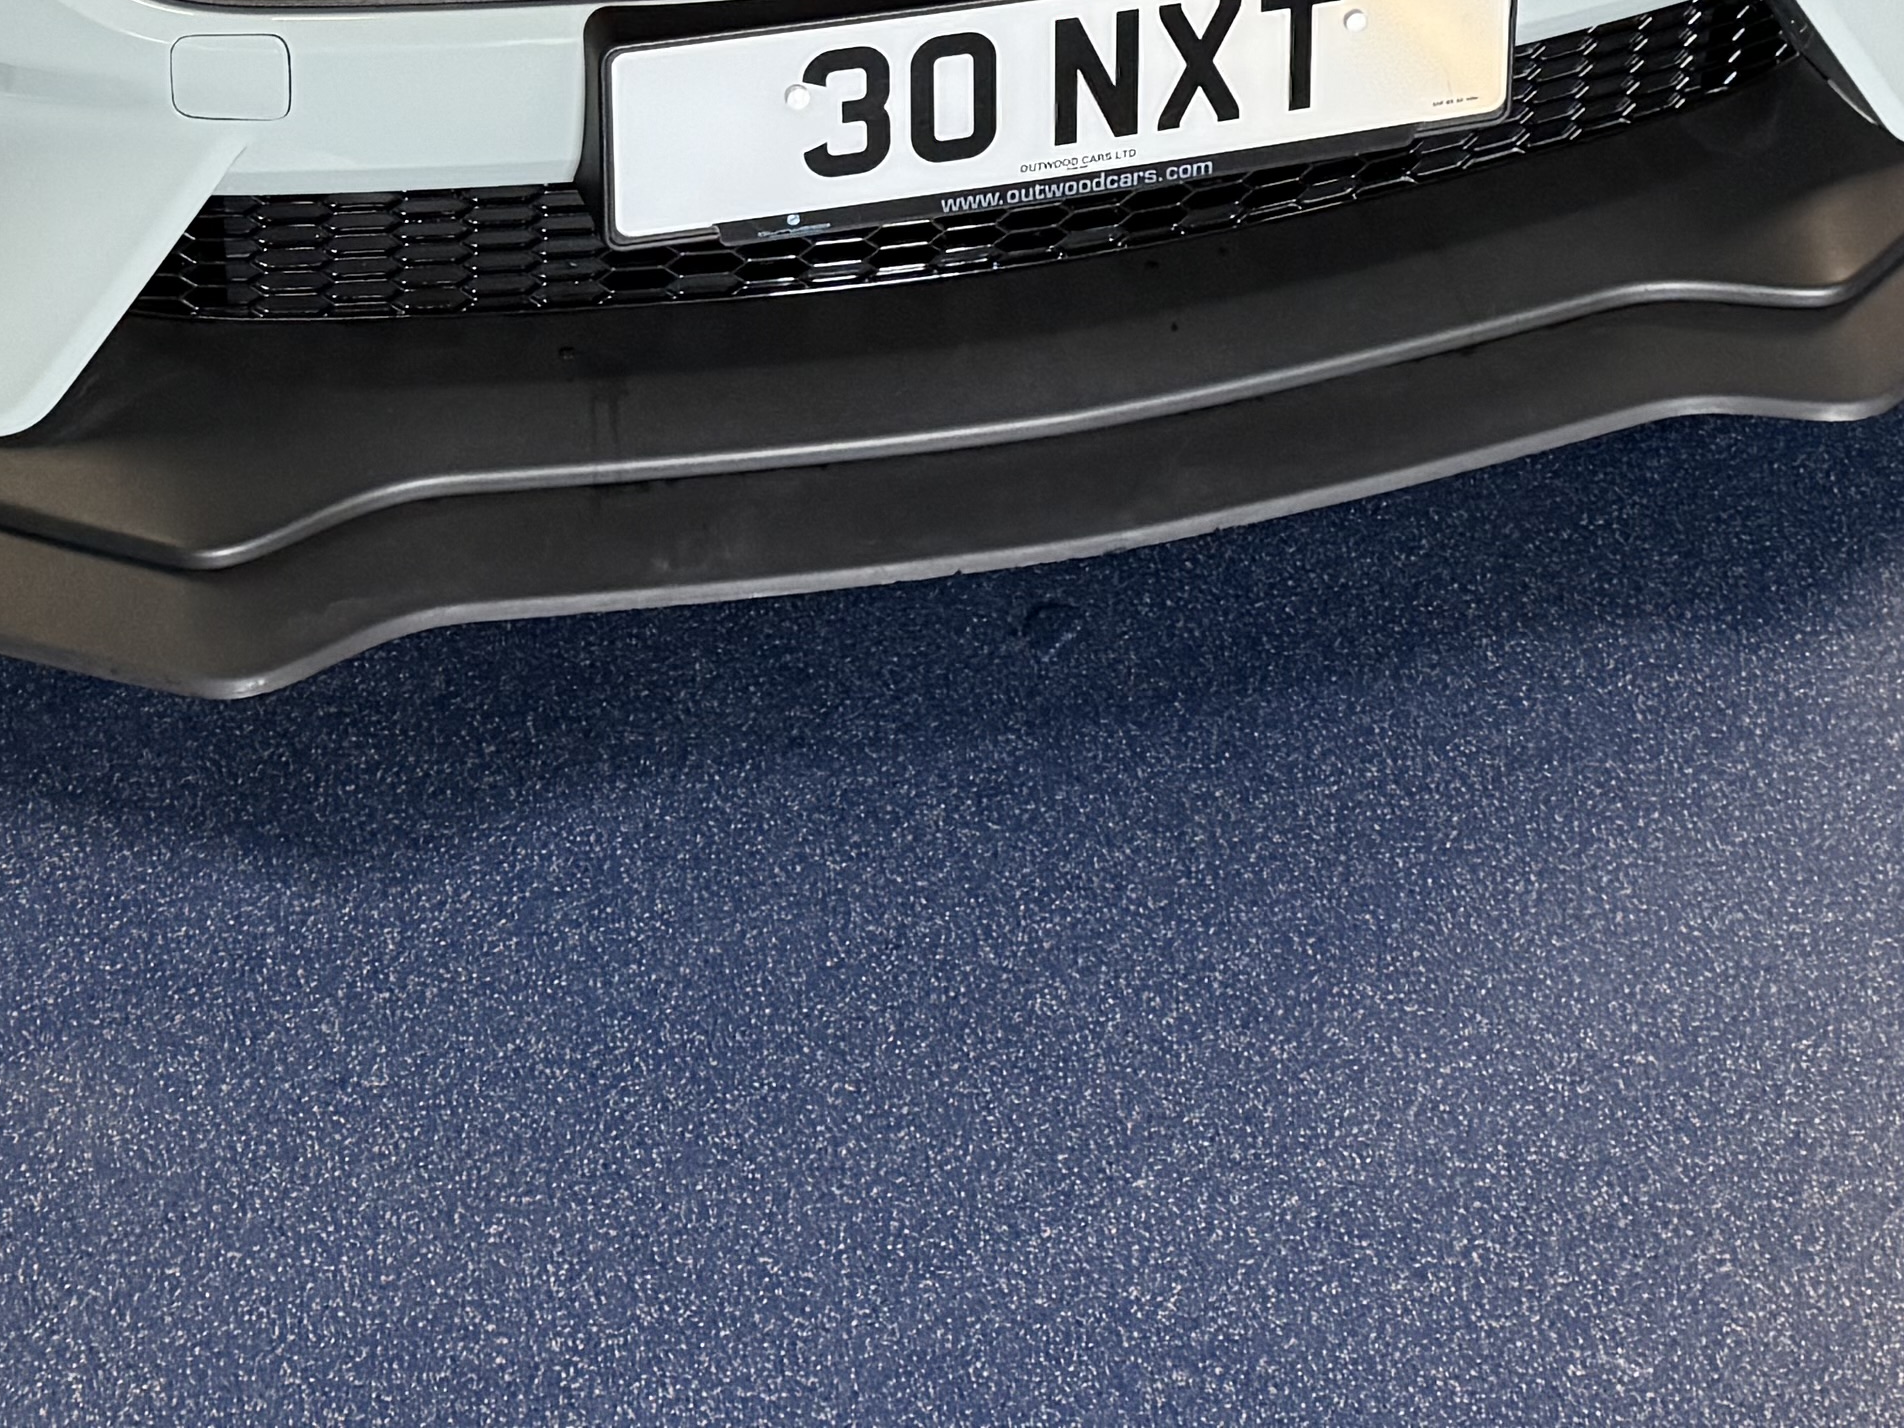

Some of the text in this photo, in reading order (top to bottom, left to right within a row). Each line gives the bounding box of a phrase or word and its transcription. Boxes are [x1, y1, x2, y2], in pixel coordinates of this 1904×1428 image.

[802, 31, 998, 179] 30
[940, 160, 1214, 214] www.outwoodcars.com
[1019, 148, 1137, 173] OUTWOOD CARS LTD
